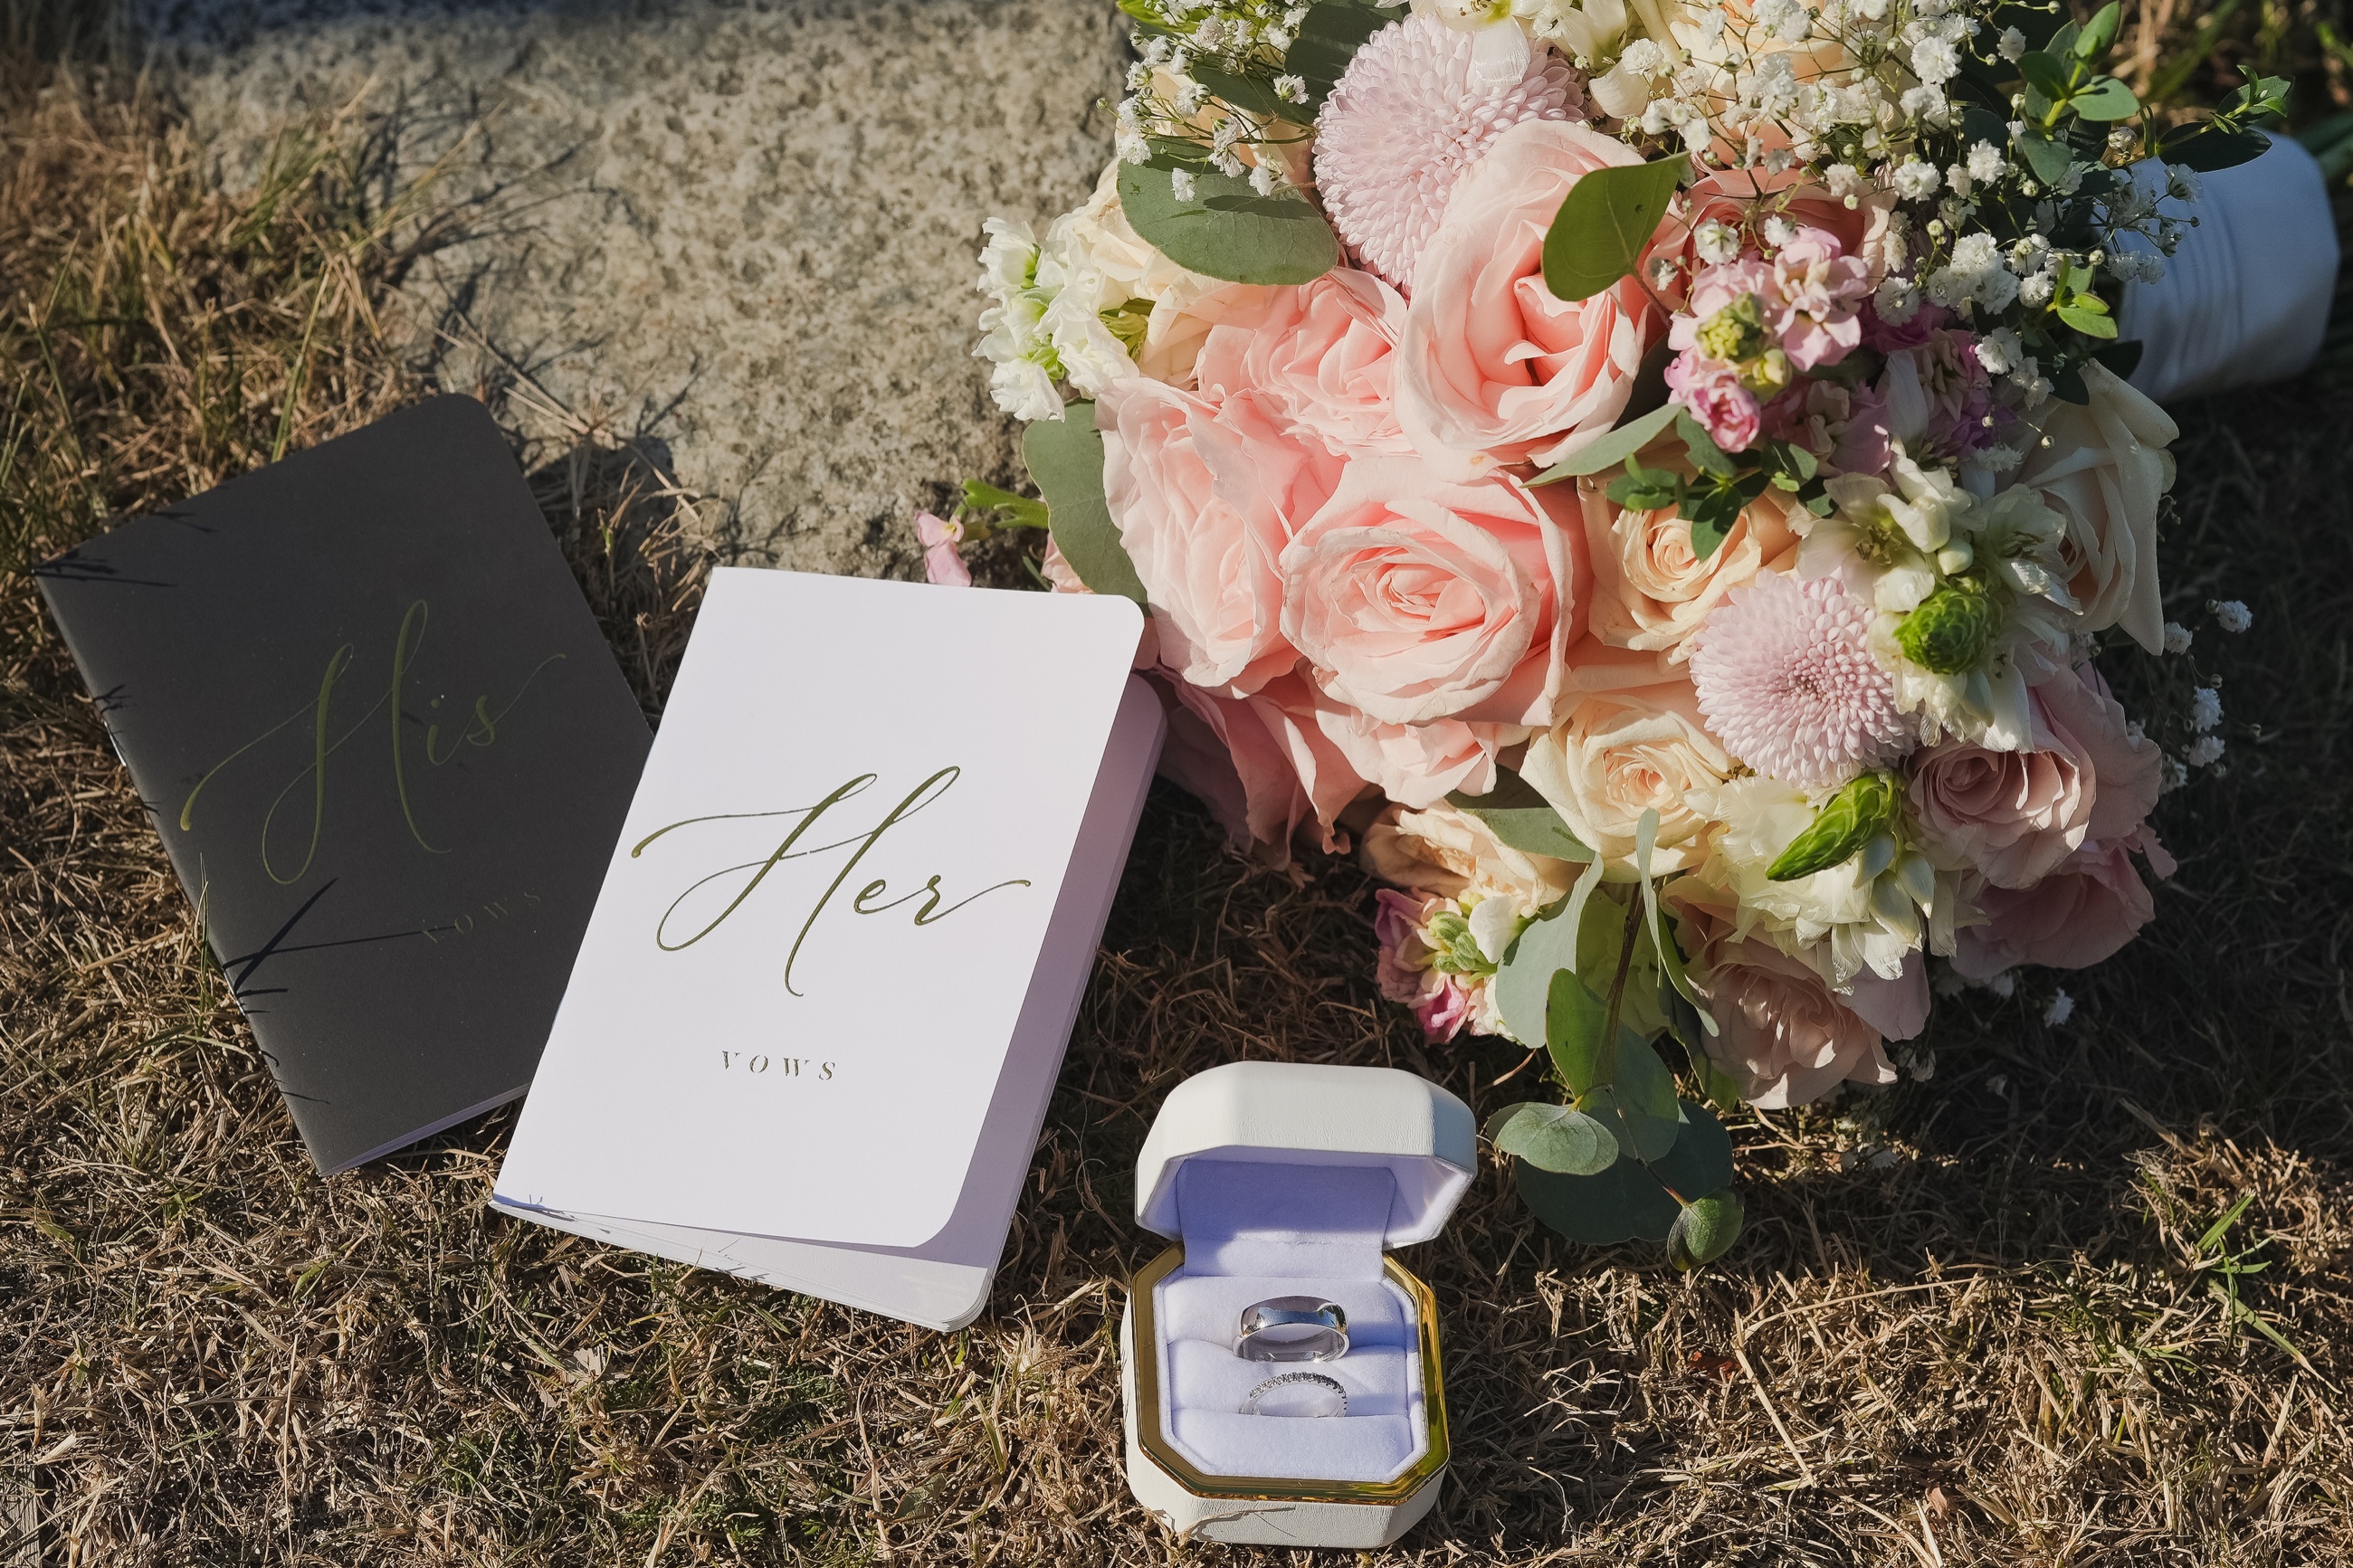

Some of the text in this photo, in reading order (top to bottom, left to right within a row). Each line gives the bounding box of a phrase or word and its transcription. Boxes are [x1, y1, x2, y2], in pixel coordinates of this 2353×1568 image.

[180, 599, 567, 885] His
[631, 765, 1031, 997] Her
[722, 1050, 835, 1080] VOWS
